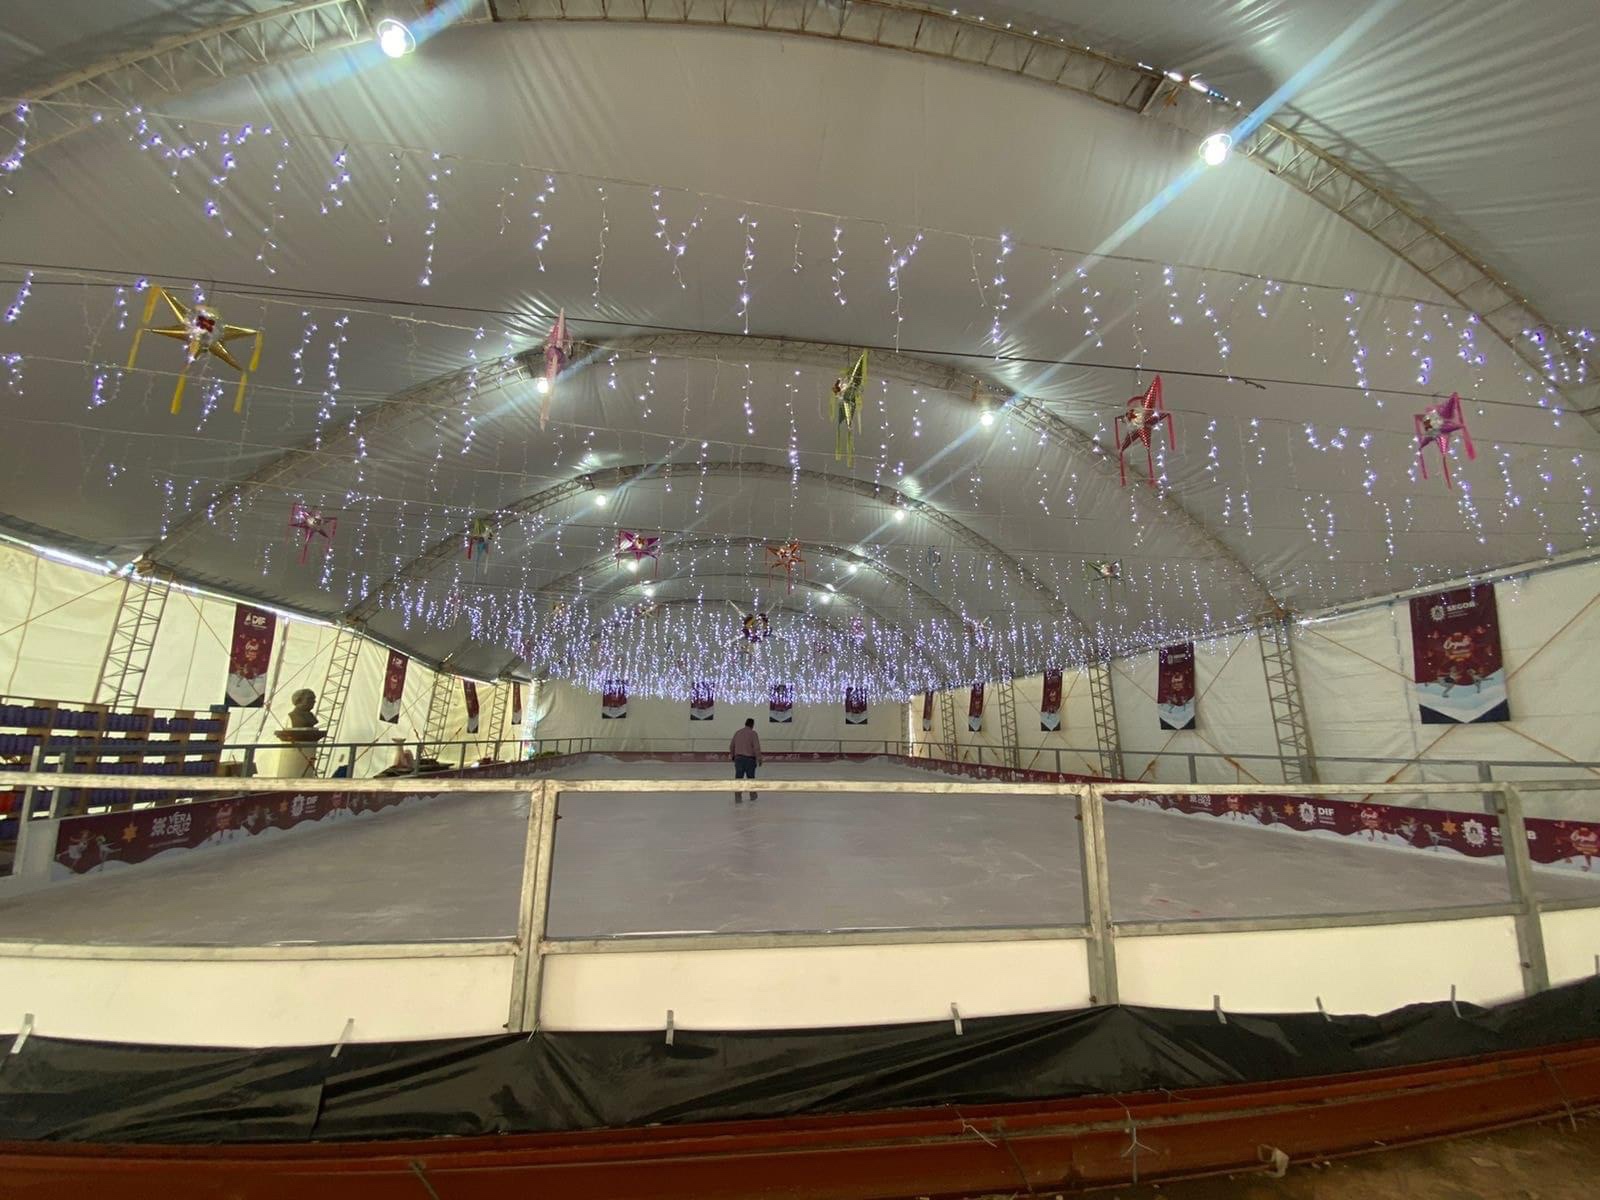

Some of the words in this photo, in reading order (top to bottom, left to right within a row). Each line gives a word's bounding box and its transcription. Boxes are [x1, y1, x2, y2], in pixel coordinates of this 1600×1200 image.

[168, 811, 192, 825] VERA
[1318, 806, 1335, 817] DIF
[167, 822, 191, 836] CRUZ
